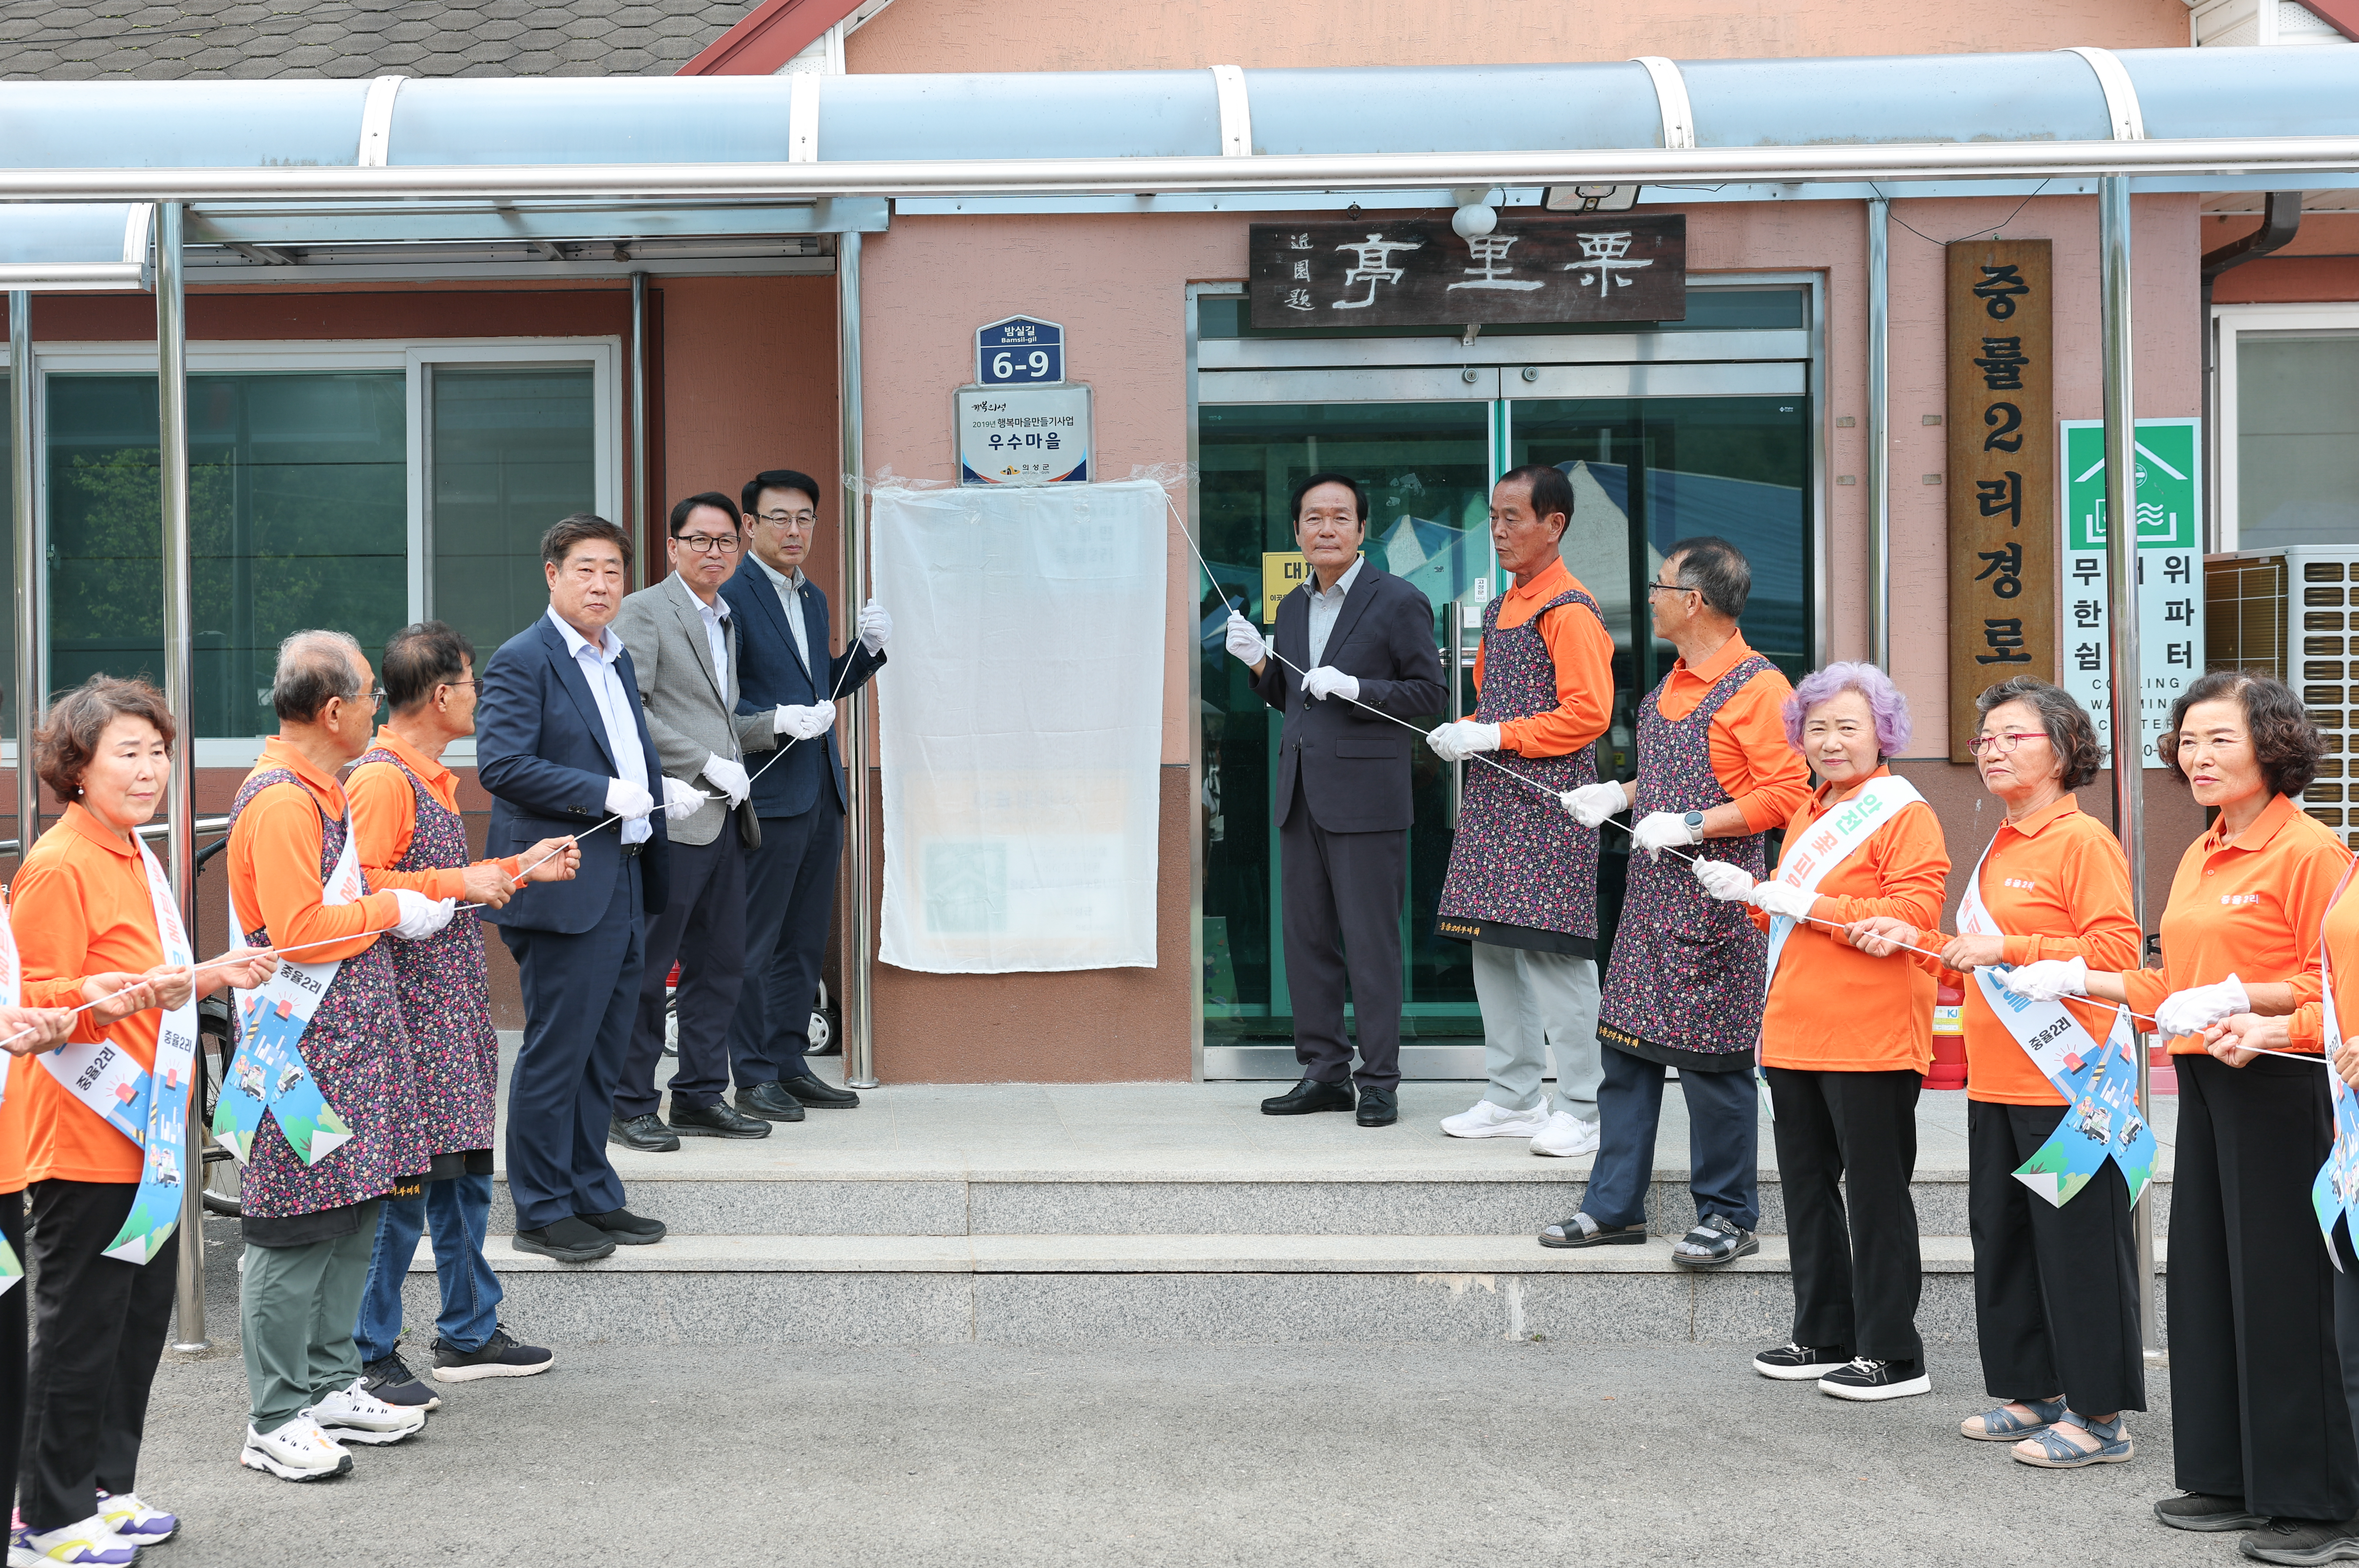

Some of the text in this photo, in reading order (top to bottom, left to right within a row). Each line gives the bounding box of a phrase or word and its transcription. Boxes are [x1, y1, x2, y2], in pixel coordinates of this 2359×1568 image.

[1004, 325, 1035, 336] 밤실길
[993, 350, 1049, 378] 6-9
[971, 401, 1006, 412] 행복의성
[997, 416, 1074, 428] 행복마을만들기사업
[988, 432, 1061, 450] 우수마을
[1973, 264, 2032, 665] 중률2리경로
[1835, 794, 1883, 836] 안전
[2004, 878, 2035, 893] 중율2리
[2221, 894, 2259, 904] 중율2리
[280, 964, 322, 995] 중율2리
[164, 1030, 192, 1053] 중율2리
[2028, 1016, 2071, 1051] 중율2리
[76, 1046, 117, 1091] 중율2리
